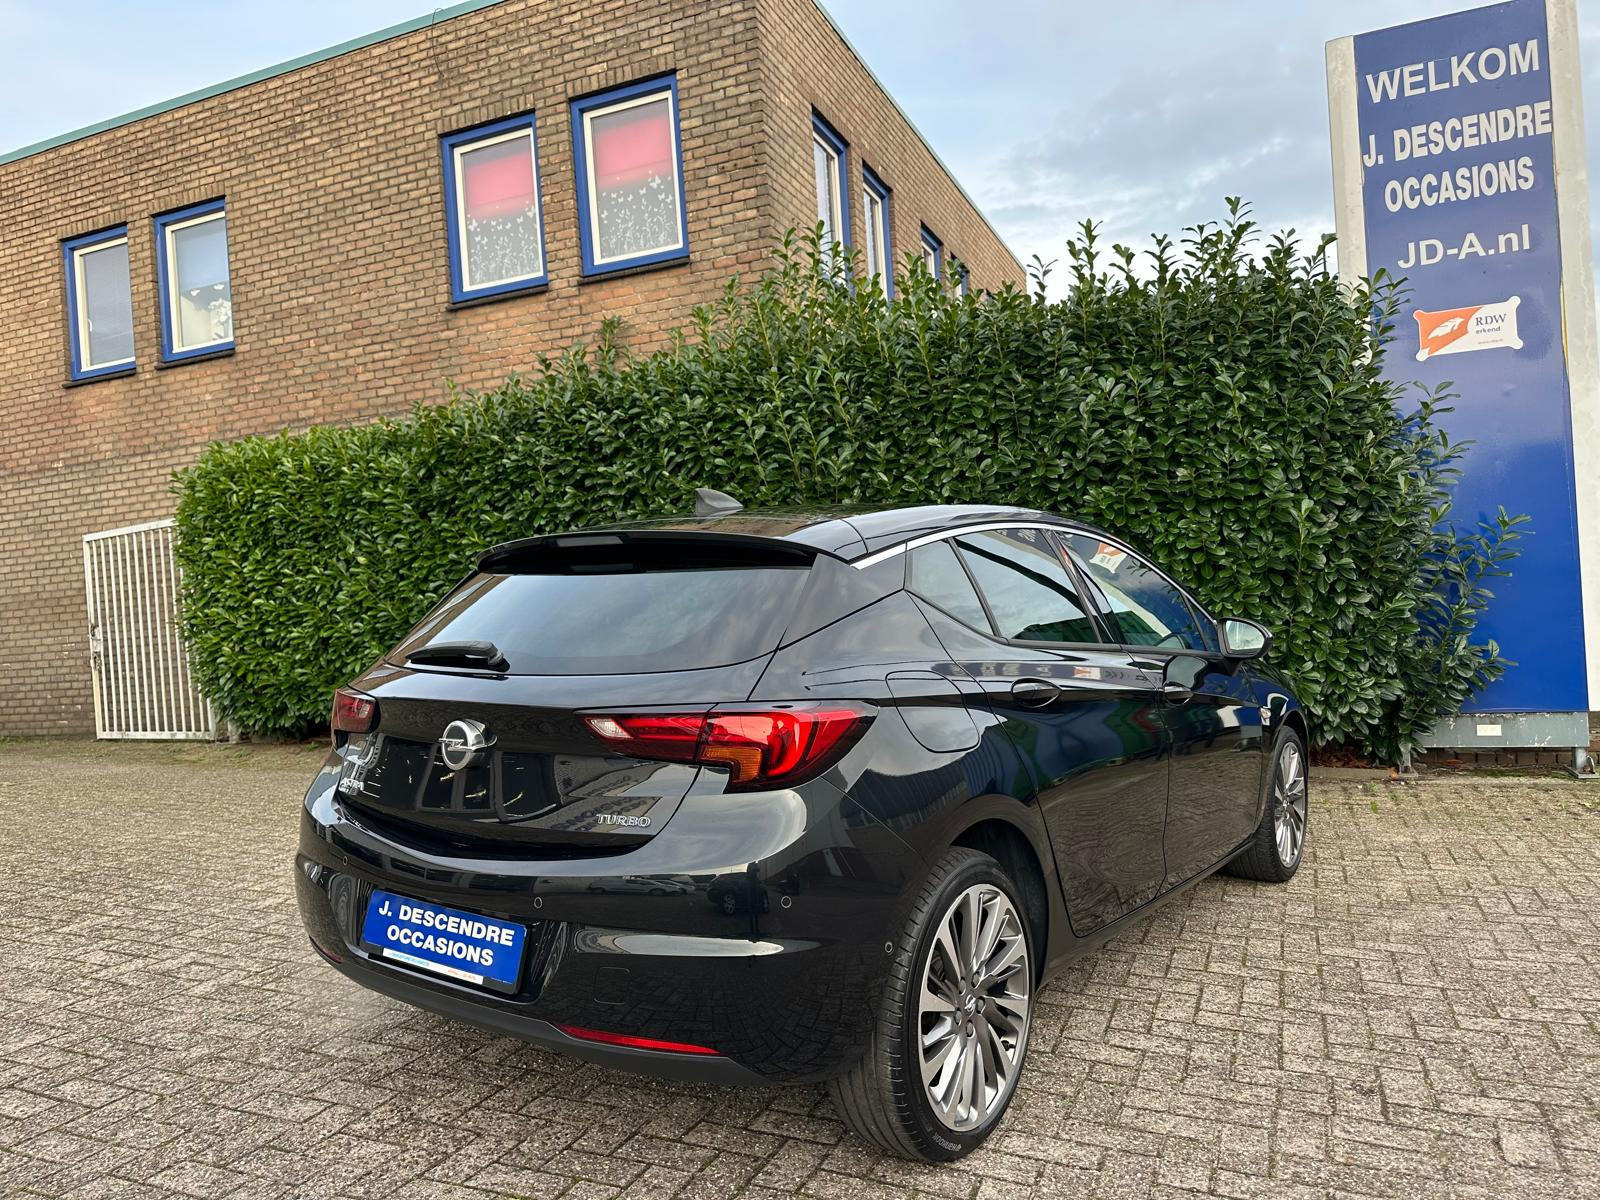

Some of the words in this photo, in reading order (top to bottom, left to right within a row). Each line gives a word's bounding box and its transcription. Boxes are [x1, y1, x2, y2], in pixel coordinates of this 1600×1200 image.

[1365, 39, 1540, 104] WELKOM
[1362, 134, 1384, 168] J.
[1393, 100, 1552, 162] DESCENDRE
[1384, 156, 1535, 213] OCCASIONS
[1397, 223, 1530, 269] JD-A.nl
[1475, 313, 1507, 327] RDW
[1475, 326, 1501, 335] erkend
[595, 813, 651, 827] TURBO
[378, 900, 393, 917] J.
[398, 904, 515, 947] DESCENDRE
[386, 924, 494, 967] OCCASIONS
